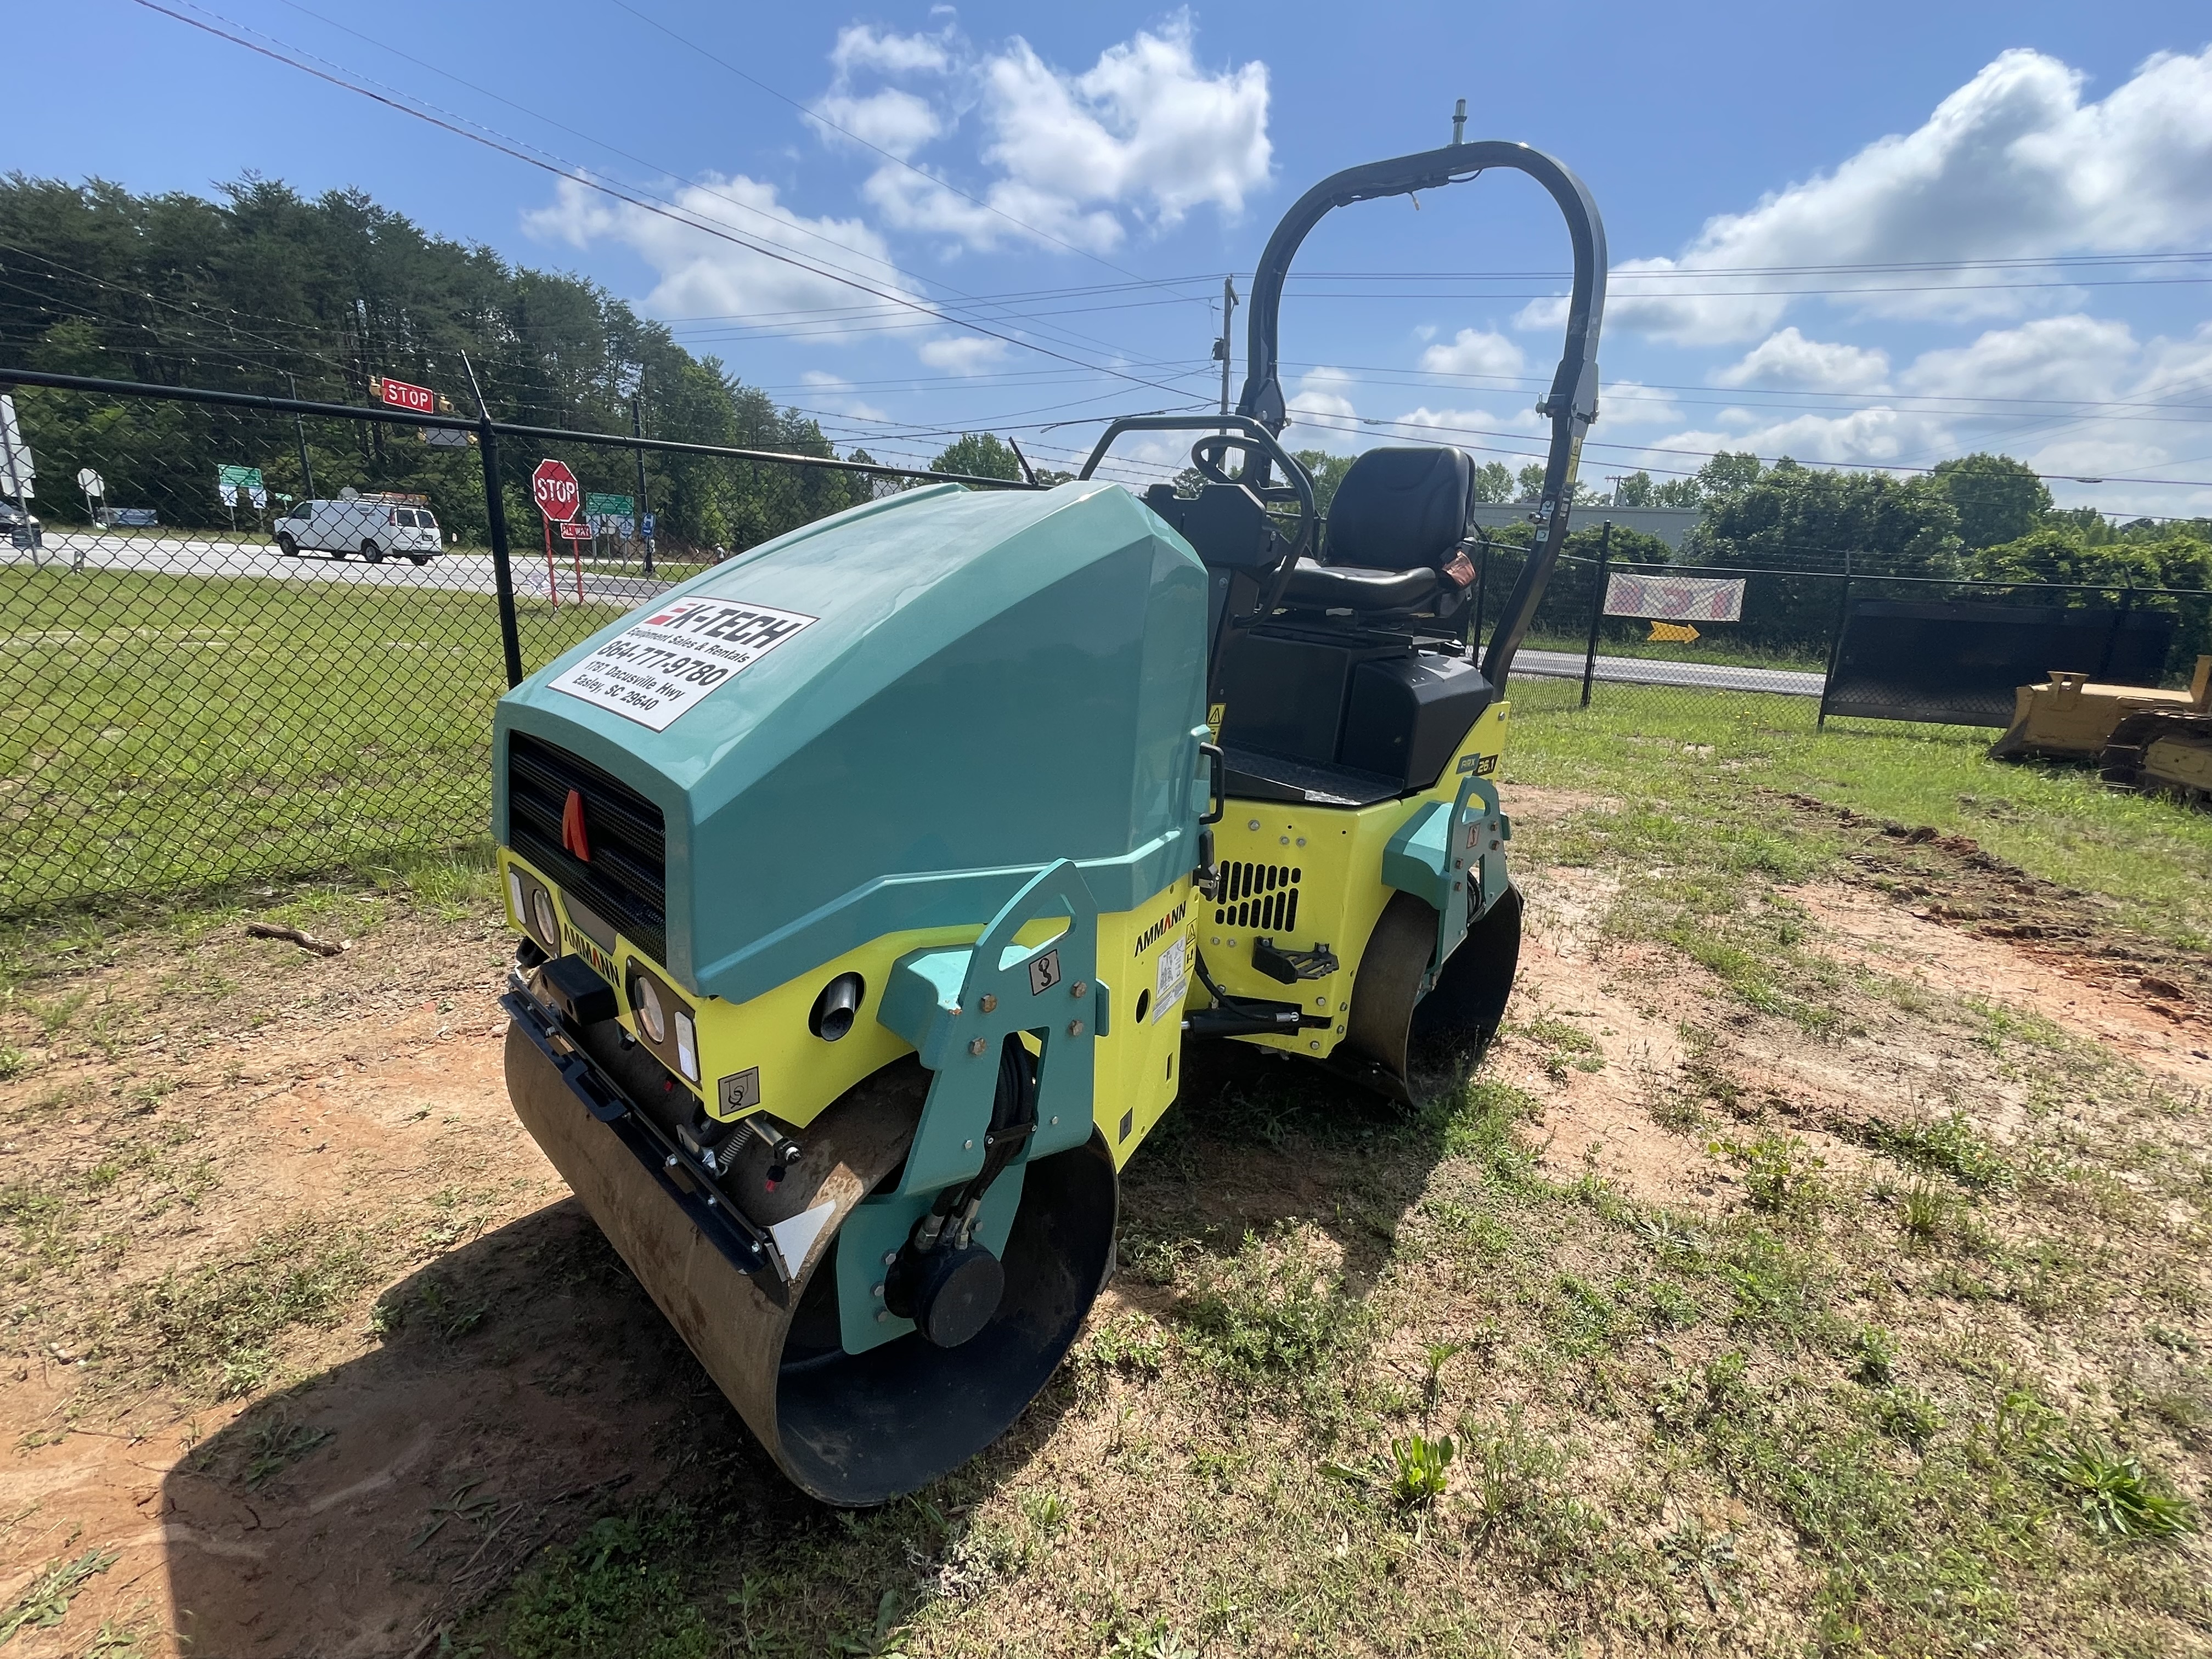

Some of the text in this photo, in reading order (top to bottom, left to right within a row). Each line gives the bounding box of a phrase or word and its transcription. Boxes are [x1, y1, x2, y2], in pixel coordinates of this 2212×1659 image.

[388, 383, 428, 407] STOP
[538, 478, 575, 503] STOP
[562, 526, 590, 537] ALL WAY
[626, 627, 751, 663] Equipment Sales & Rentals
[664, 604, 803, 650] K-TECH
[584, 660, 686, 702] 1787 Dacusville Hwy
[596, 640, 729, 686] 864-777-9780
[572, 674, 659, 711] Easley, SC 29640
[1460, 758, 1494, 774] ARX 26.1
[1134, 900, 1187, 958] AMMANN
[563, 922, 621, 989] AMMANN
